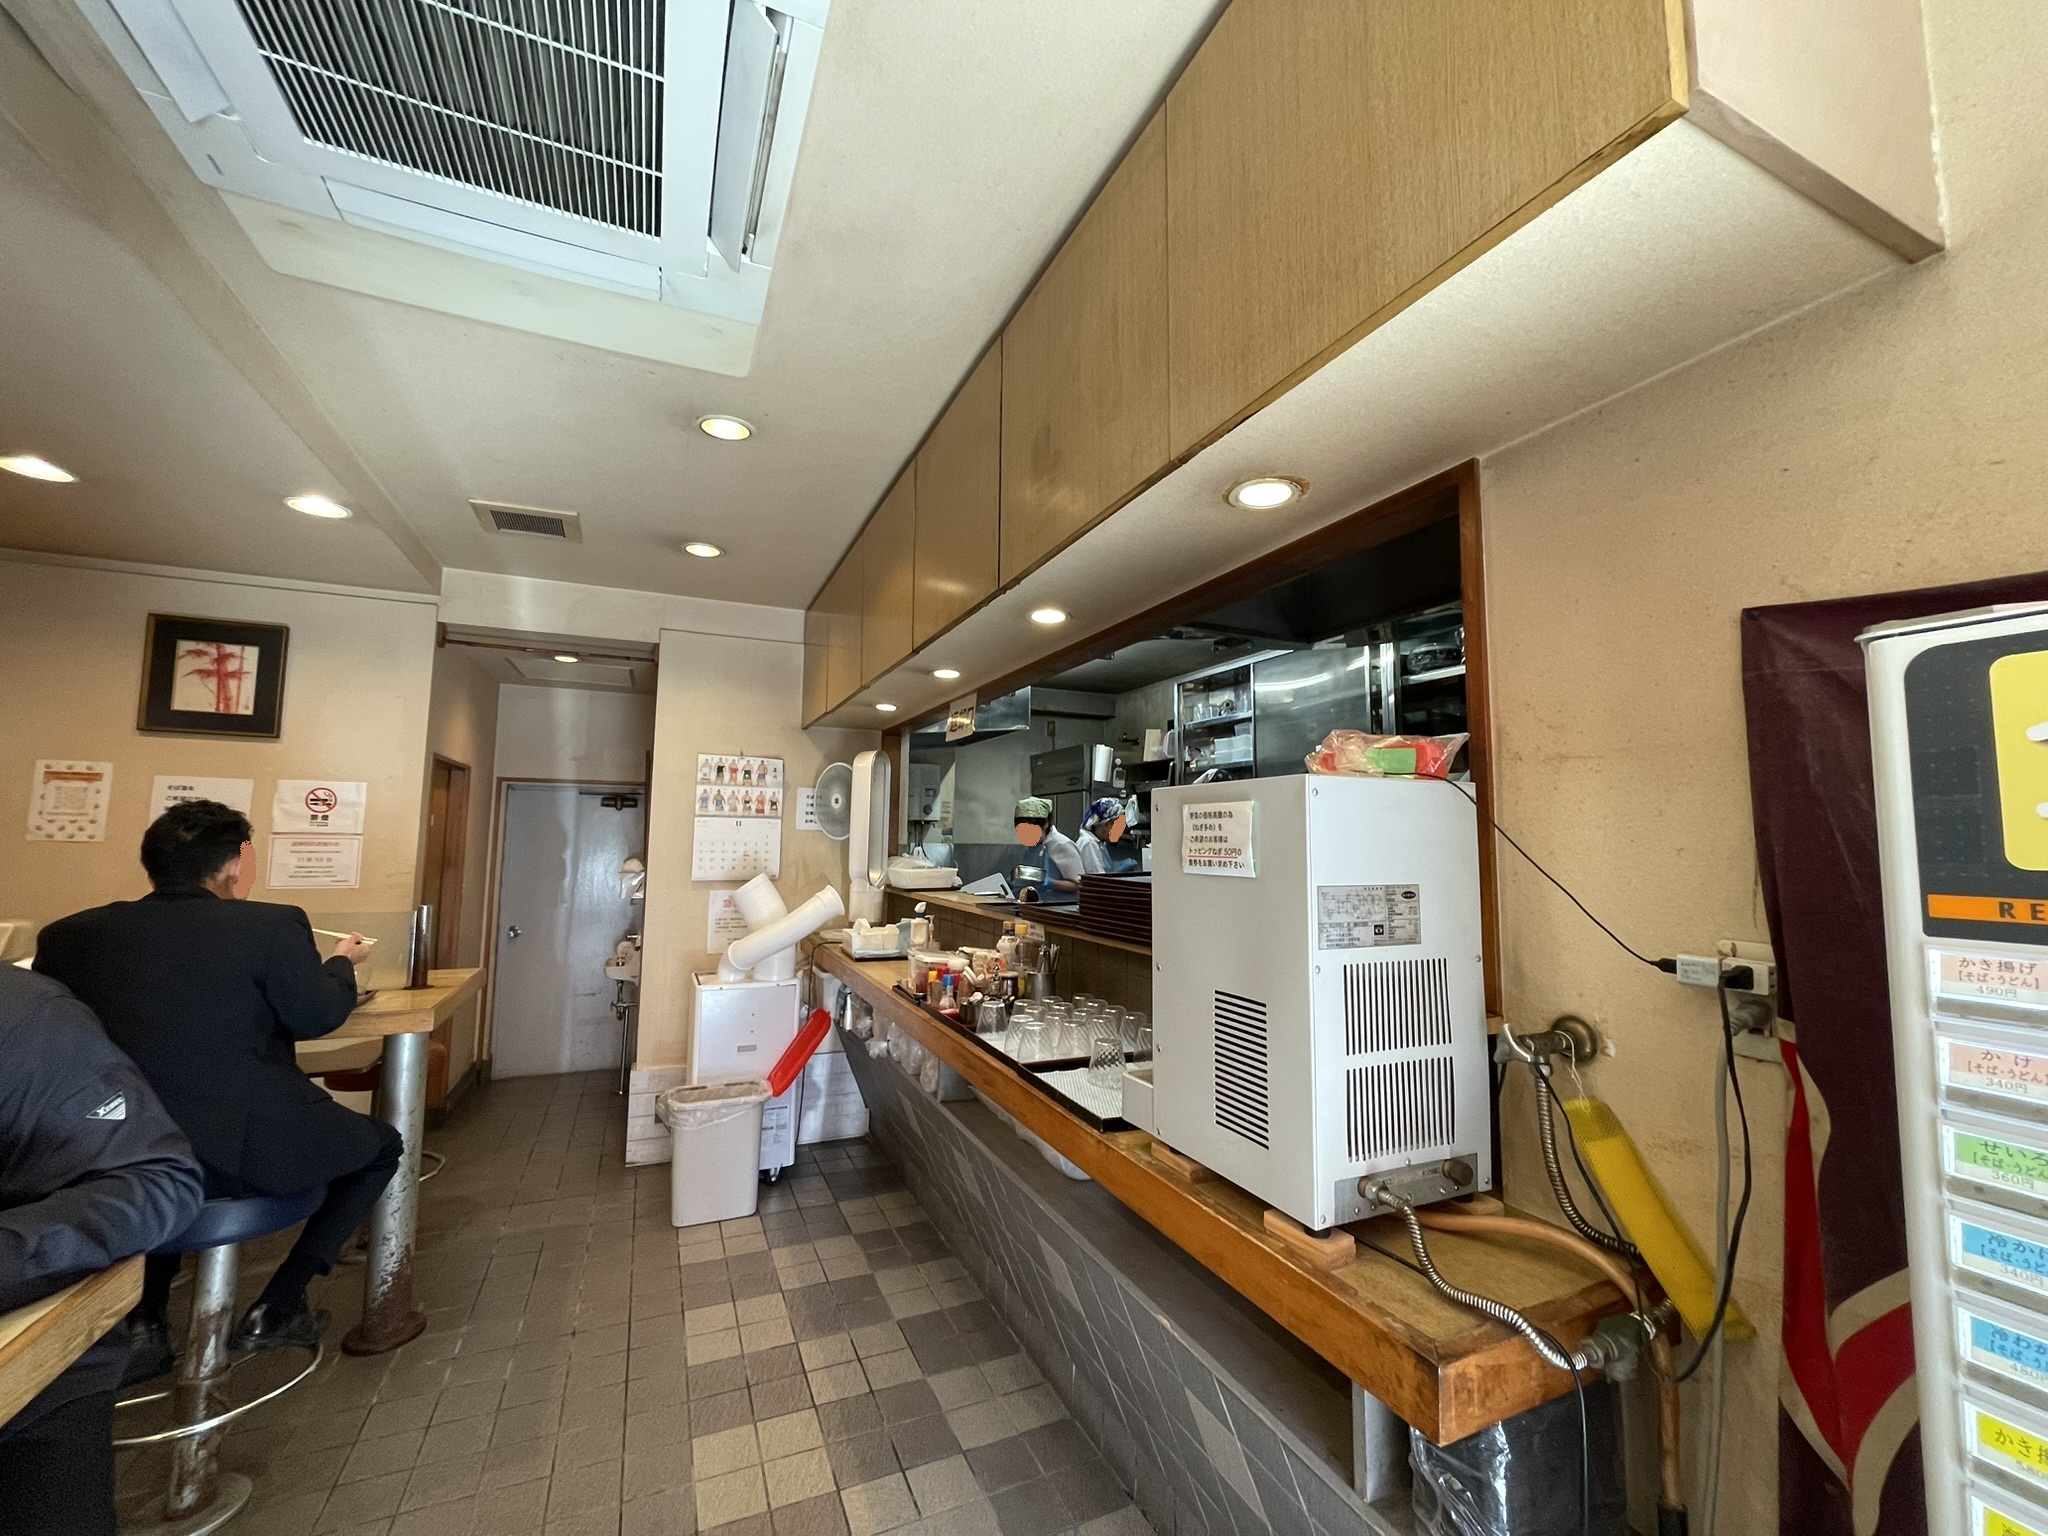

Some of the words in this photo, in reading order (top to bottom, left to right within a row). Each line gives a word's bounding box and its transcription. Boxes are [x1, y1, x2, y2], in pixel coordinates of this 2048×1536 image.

[1959, 957, 2037, 975] かき揚げ
[1976, 986, 2018, 999] 490円
[1981, 1049, 2031, 1068] かけ
[1985, 1077, 2028, 1093] 340円
[1979, 1141, 2048, 1167] せいろ
[1991, 1170, 2034, 1190] 360円
[2000, 1264, 2044, 1287] 340円
